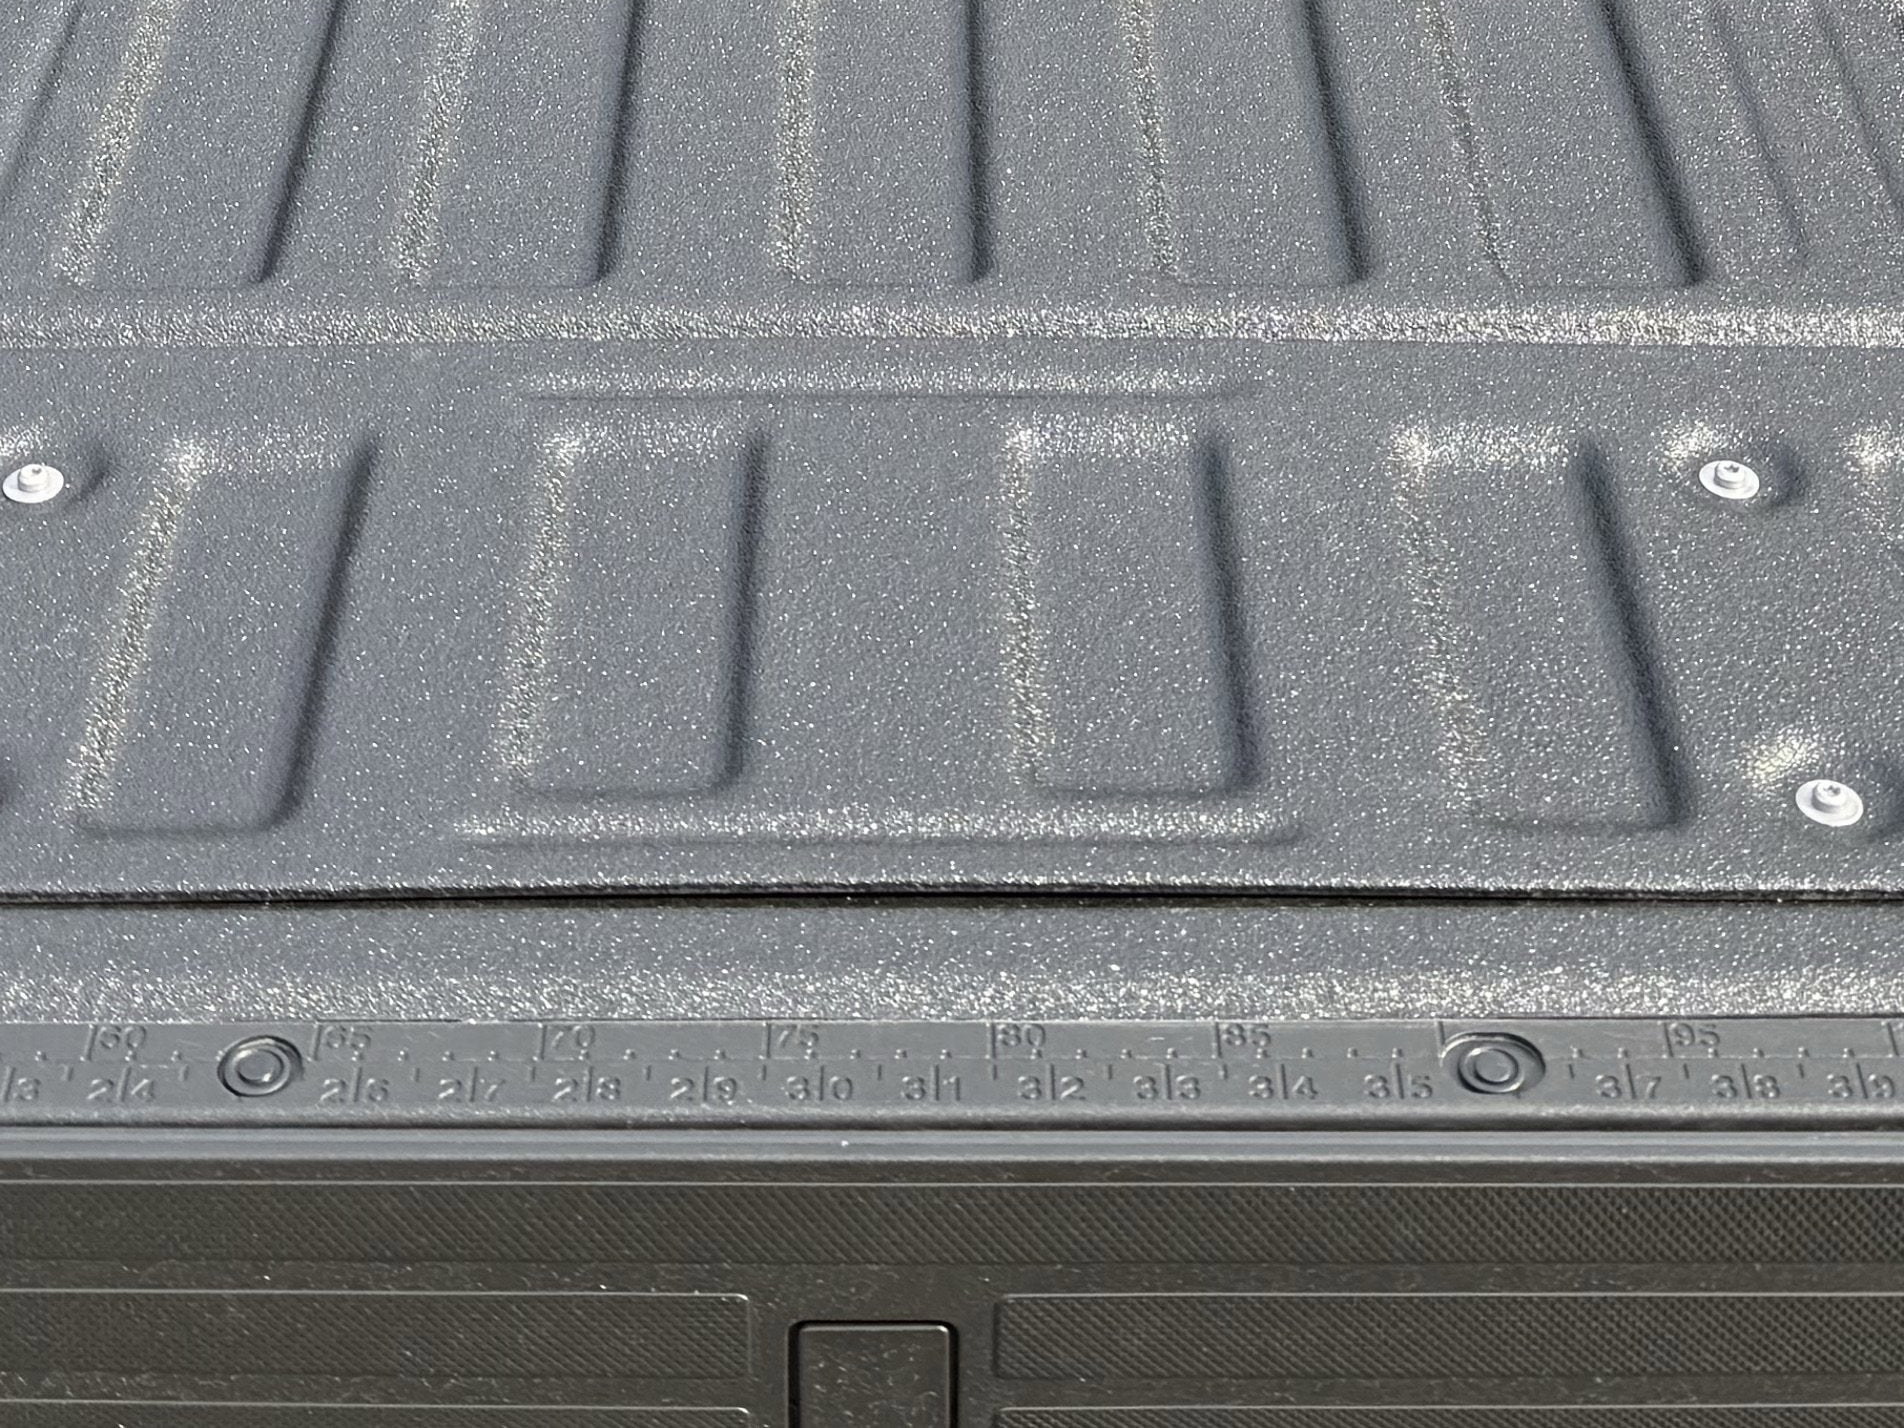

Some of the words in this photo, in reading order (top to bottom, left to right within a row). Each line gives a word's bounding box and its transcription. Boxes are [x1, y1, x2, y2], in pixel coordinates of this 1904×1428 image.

[95, 1025, 148, 1048] 60
[322, 1025, 372, 1048] 65
[548, 1024, 596, 1048] 70
[776, 1024, 820, 1048] 75
[996, 1023, 1047, 1047] 80
[1222, 1023, 1273, 1047] 85
[1670, 1022, 1721, 1046] 95
[85, 1077, 157, 1102] 24
[319, 1077, 391, 1102] 26
[436, 1077, 508, 1102] 27
[551, 1076, 621, 1102] 28
[668, 1076, 739, 1103] 29
[780, 1076, 854, 1102] 30
[899, 1076, 962, 1102] 31
[1016, 1075, 1088, 1101] 32
[1132, 1075, 1202, 1101] 33
[1247, 1075, 1319, 1101] 34
[1362, 1075, 1434, 1100] 35
[1594, 1074, 1663, 1100] 37
[1710, 1074, 1781, 1100] 38
[1826, 1074, 1896, 1100] 39
